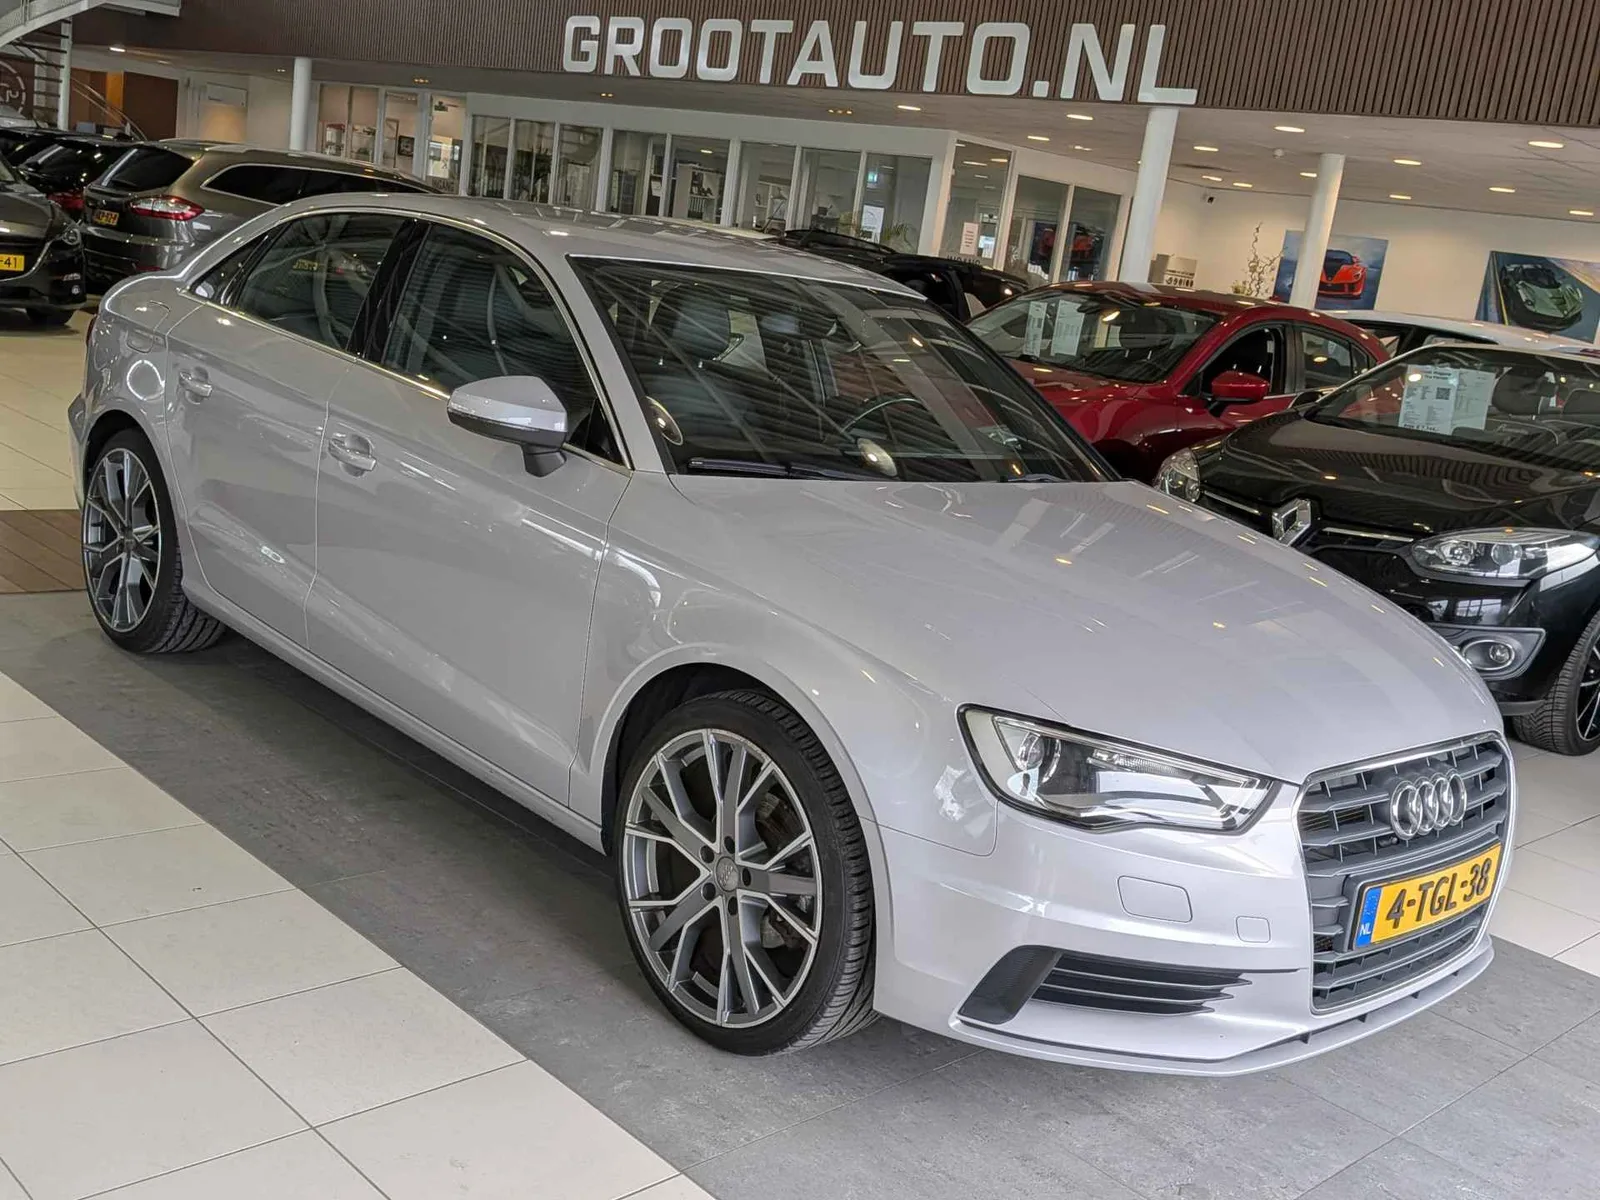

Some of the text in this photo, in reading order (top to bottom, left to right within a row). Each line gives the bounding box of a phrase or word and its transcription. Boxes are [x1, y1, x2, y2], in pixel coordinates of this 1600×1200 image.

[562, 14, 1198, 105] GROOTAUTO.NL
[1386, 857, 1492, 929] 4-TGL-38
[1359, 923, 1371, 936] NL
